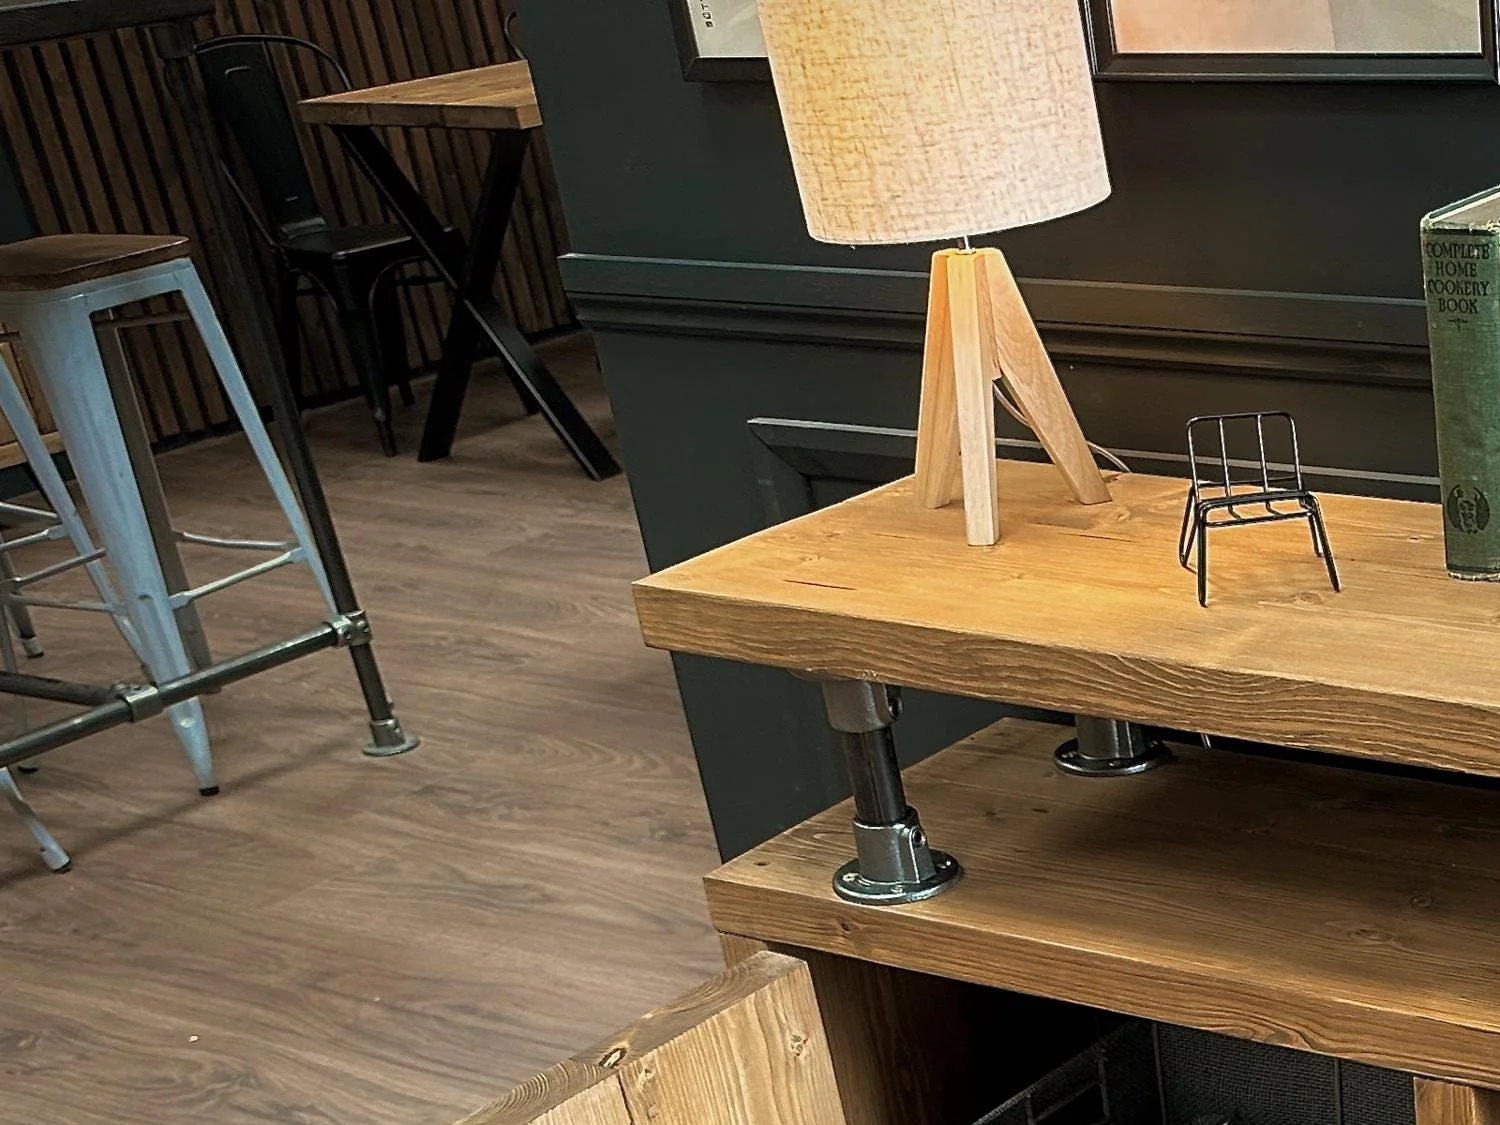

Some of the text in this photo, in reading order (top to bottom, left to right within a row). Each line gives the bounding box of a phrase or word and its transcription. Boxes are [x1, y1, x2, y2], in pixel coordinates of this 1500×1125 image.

[1426, 242, 1490, 260] COMPLETE
[1435, 261, 1478, 278] HOME
[1427, 279, 1490, 297] COOKERY
[1438, 297, 1479, 315] BOOK
